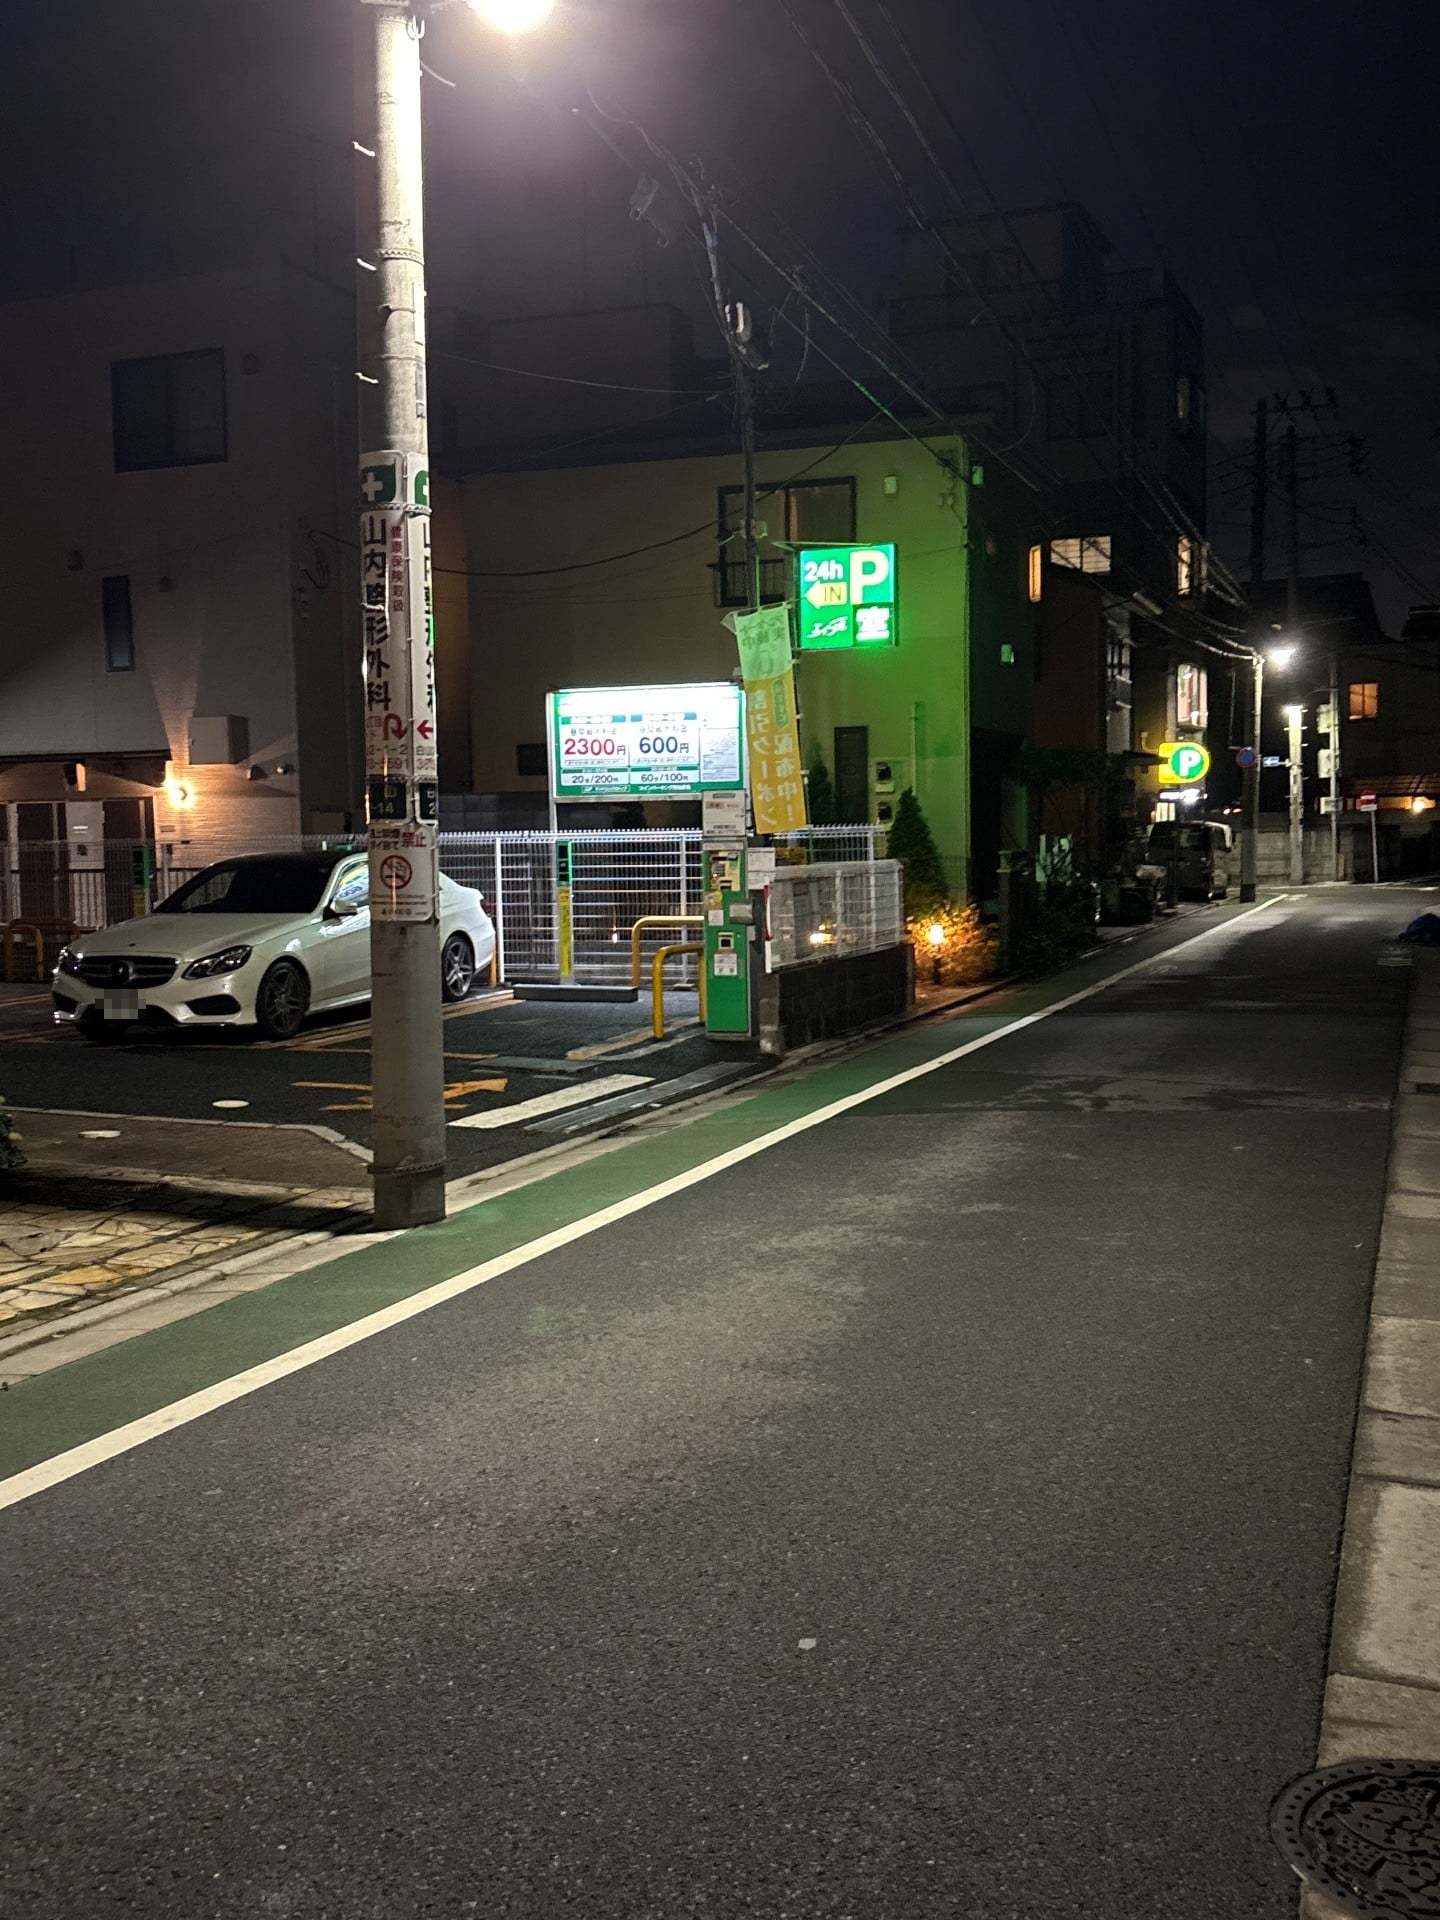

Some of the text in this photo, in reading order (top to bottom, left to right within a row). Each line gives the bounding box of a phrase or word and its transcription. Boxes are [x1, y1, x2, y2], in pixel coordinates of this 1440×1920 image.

[804, 559, 844, 583] 24h
[850, 550, 890, 605] P
[824, 585, 842, 602] IN
[564, 738, 626, 756] 2300円
[639, 736, 689, 754] 600円
[1179, 749, 1201, 777] P
[402, 832, 427, 848] 禁止
